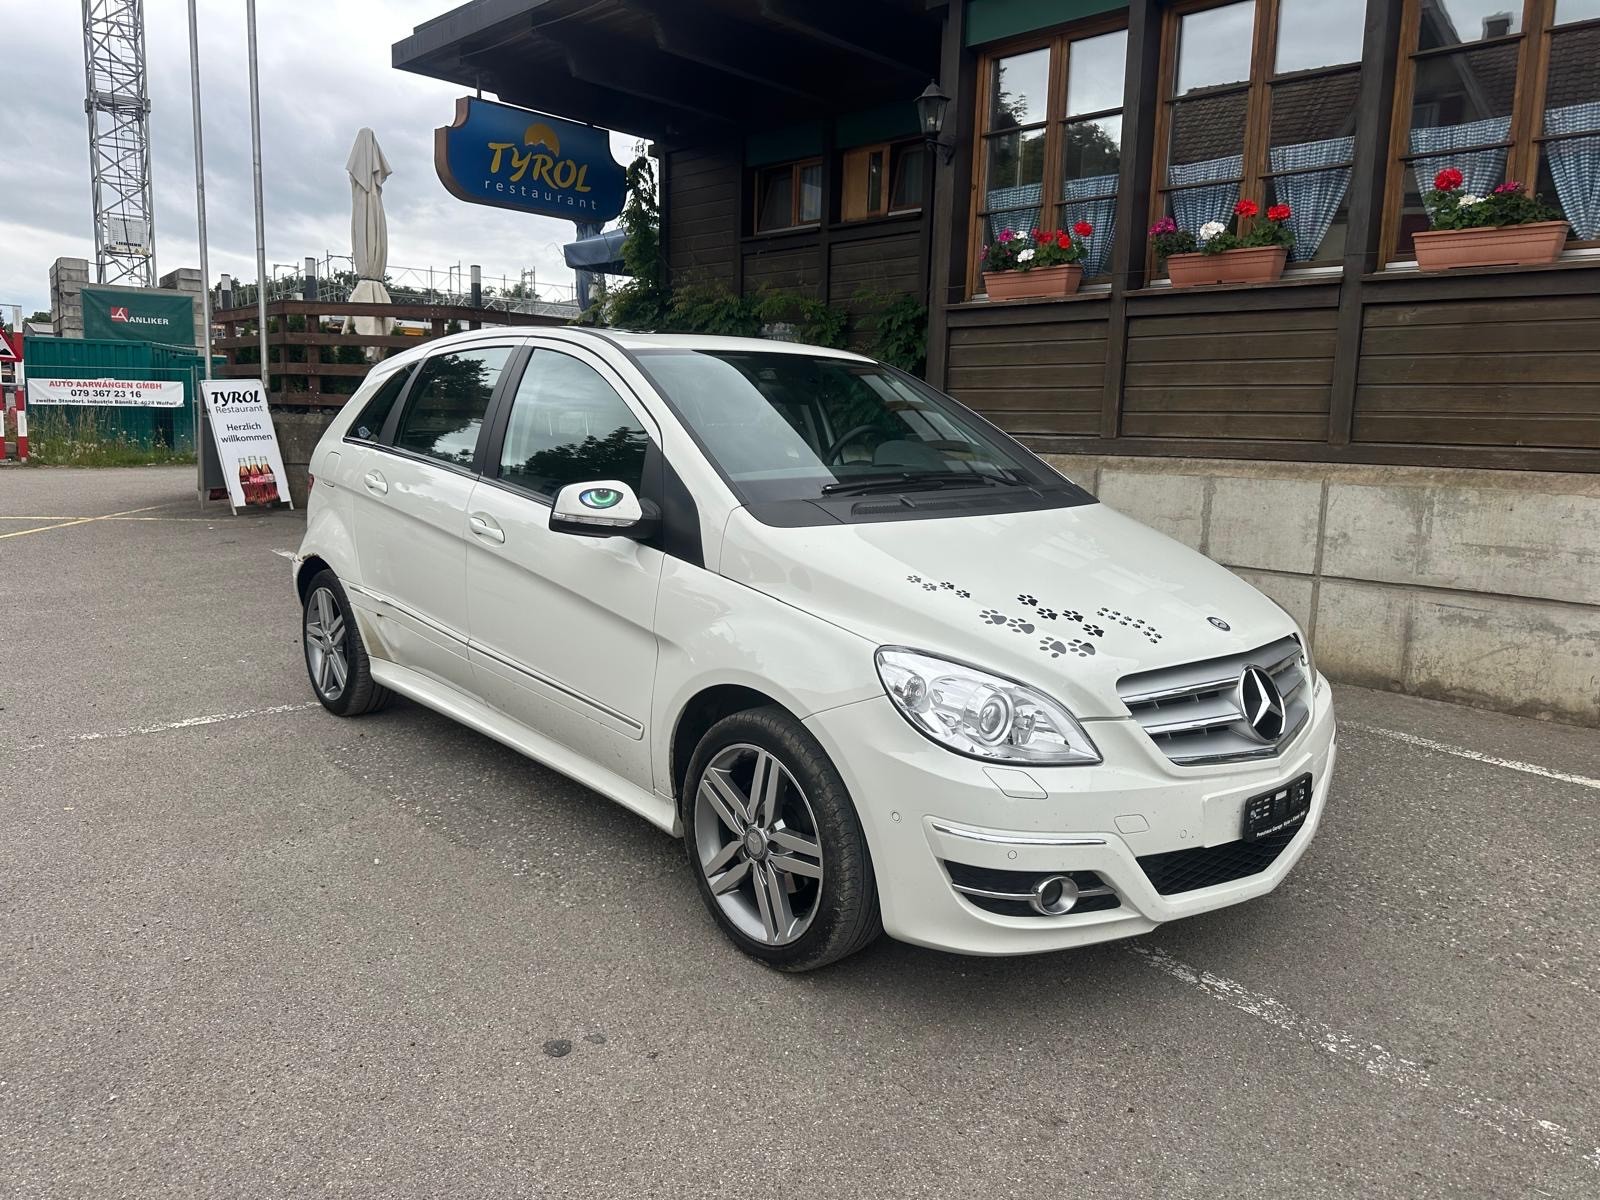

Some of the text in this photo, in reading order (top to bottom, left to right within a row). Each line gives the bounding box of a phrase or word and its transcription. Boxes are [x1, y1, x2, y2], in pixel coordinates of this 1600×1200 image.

[487, 142, 591, 193] TYROL
[484, 179, 597, 210] restaurant
[128, 316, 169, 325] ANLIKER
[49, 380, 74, 388] AUTO
[136, 382, 162, 390] GMBH
[70, 389, 90, 397] 079
[92, 389, 111, 397] 367
[113, 390, 126, 398] 23
[211, 390, 261, 407] TYROL
[215, 404, 264, 414] Restaurant
[226, 422, 262, 431] Herzlich
[220, 433, 273, 443] willkommen
